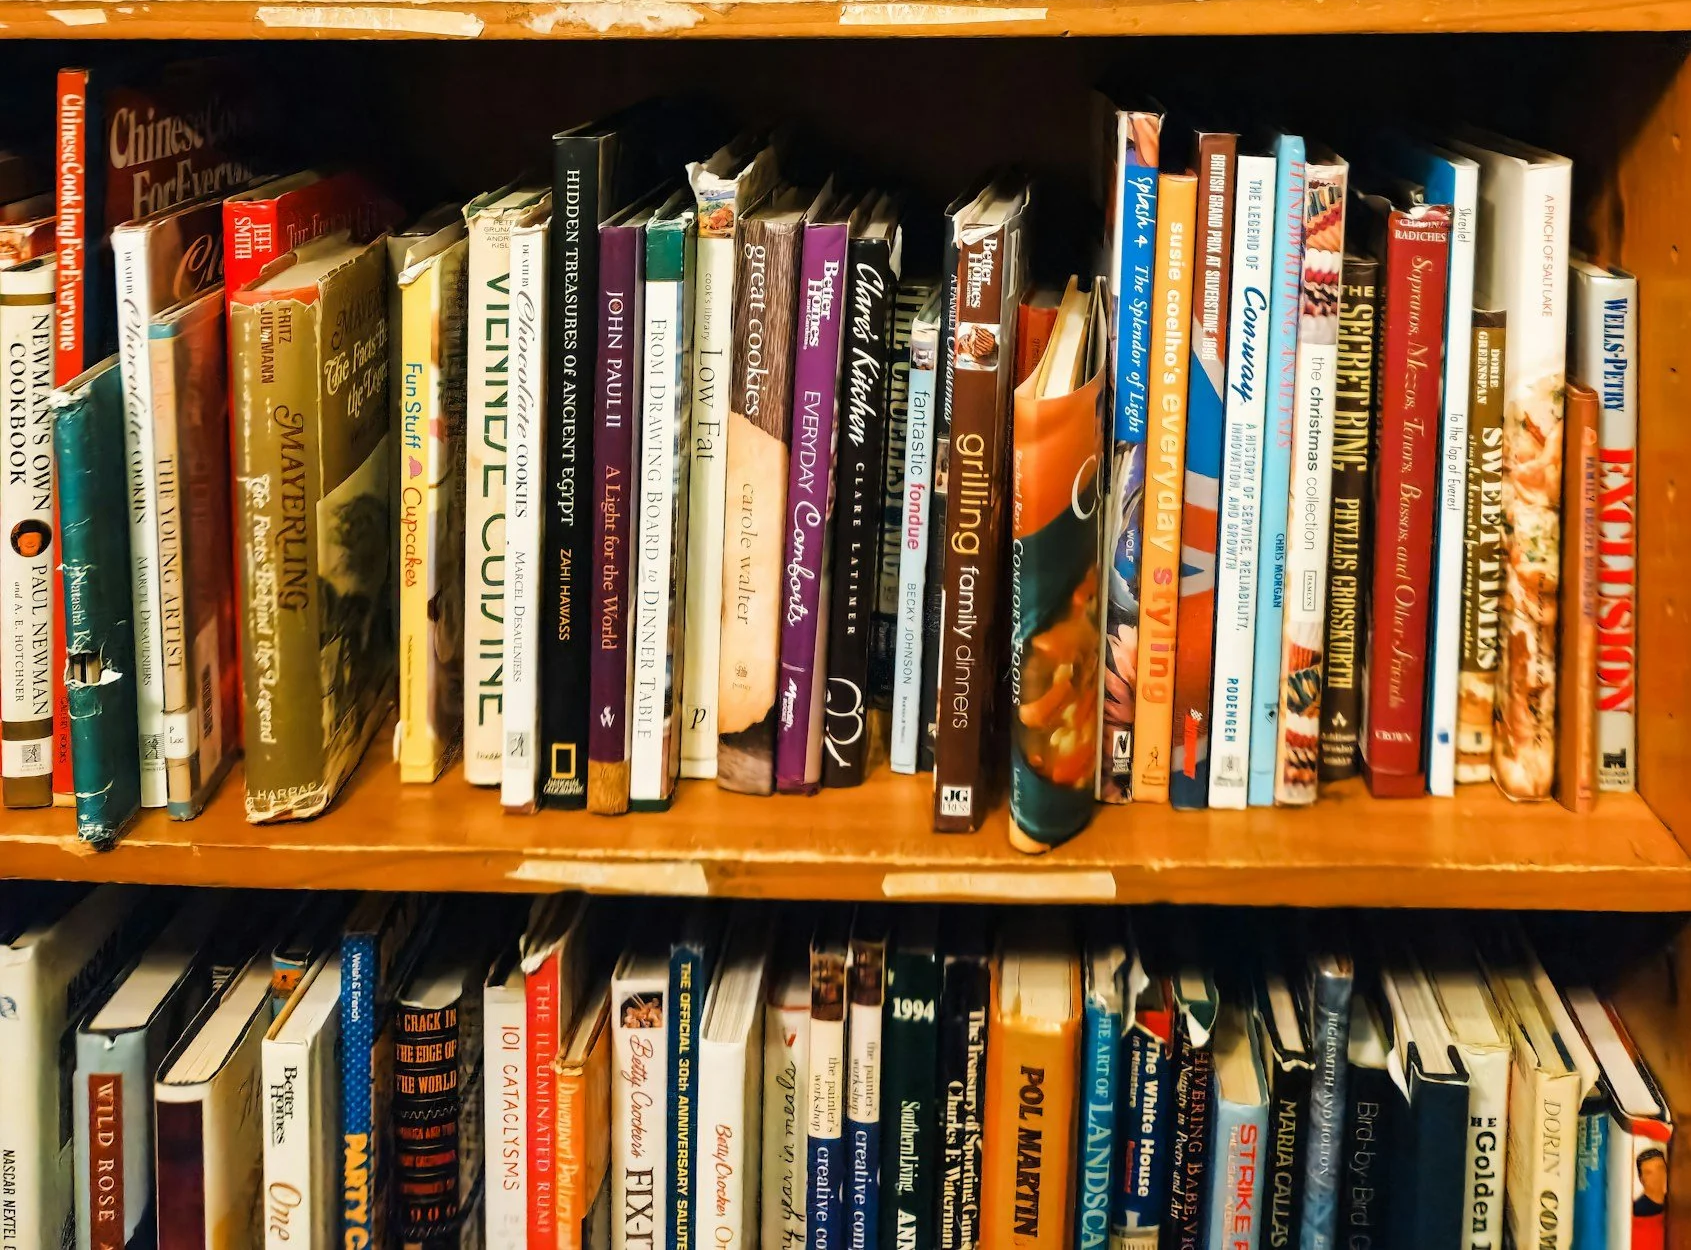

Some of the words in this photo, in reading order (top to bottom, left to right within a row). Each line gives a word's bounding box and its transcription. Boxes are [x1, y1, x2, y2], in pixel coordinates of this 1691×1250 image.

[566, 169, 581, 244] HIDDEN
[1128, 177, 1153, 232] Splash
[234, 216, 252, 260] SMITH
[253, 221, 272, 252] JEFF
[1138, 236, 1148, 248] 4
[564, 250, 579, 350] TREASURES
[1134, 266, 1150, 293] The
[605, 291, 624, 350] JOHN
[1128, 297, 1147, 367] Splendor
[406, 363, 422, 397] Fun
[562, 354, 577, 378] OF
[1125, 369, 1145, 390] of
[1311, 356, 1325, 381] the
[1603, 298, 1628, 412] WELLS-PETRY
[605, 359, 623, 408] PAUL
[405, 401, 421, 449] Stuff
[562, 382, 577, 462] ANCIENT
[605, 414, 622, 428] II
[909, 390, 932, 476] fantastic
[1124, 392, 1144, 434] Light
[1308, 387, 1322, 471] christmas
[557, 466, 576, 527] EGYPT
[606, 465, 621, 479] A
[601, 483, 621, 531] Light
[907, 482, 925, 551] fondue
[1304, 477, 1320, 550] collection
[401, 486, 422, 588] Cupcakes
[604, 534, 620, 560] for
[14, 581, 22, 599] and
[31, 563, 48, 614] PAUL
[560, 549, 573, 581] ZAHI
[602, 564, 618, 591] the
[14, 603, 23, 615] A.
[15, 619, 23, 630] E.
[559, 585, 572, 641] HAWASS
[602, 595, 618, 650] World
[907, 583, 916, 623] BECKY
[15, 635, 24, 703] HOTCHNER
[31, 619, 49, 716] NEWMAN
[902, 626, 915, 685] JOHNSON
[892, 998, 935, 1023] 1994
[1146, 1041, 1160, 1075] The
[97, 1081, 114, 1147] WILD
[1018, 1065, 1045, 1120] POL
[1140, 1080, 1160, 1134] White
[1276, 1100, 1297, 1167] MARIA
[2, 1149, 15, 1195] NASCAR
[97, 1159, 115, 1221] ROSE
[1014, 1127, 1043, 1237] MARTIN
[1137, 1139, 1155, 1197] House
[3, 1199, 16, 1240] NEXTEL
[1271, 1170, 1292, 1247] CALLAS
